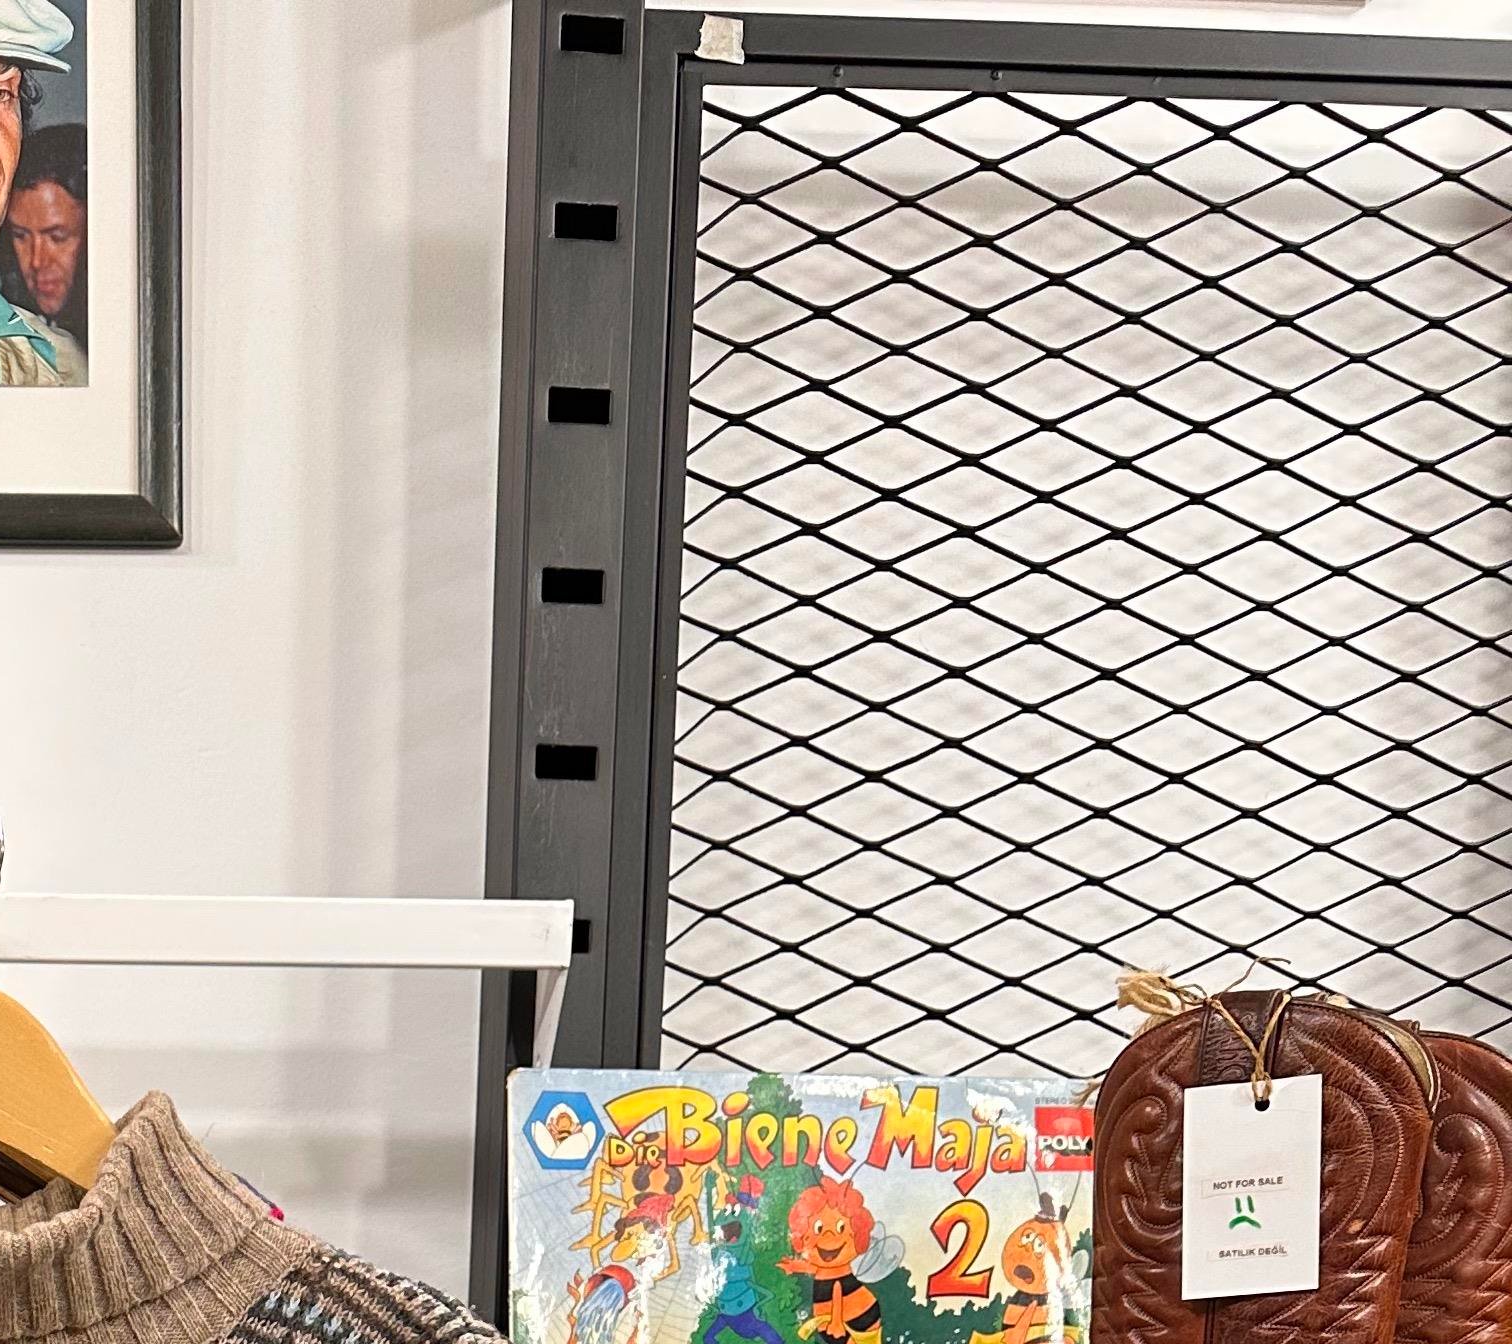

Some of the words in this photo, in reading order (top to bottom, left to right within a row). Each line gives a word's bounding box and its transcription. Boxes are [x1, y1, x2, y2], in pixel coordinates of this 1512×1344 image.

[603, 1086, 857, 1176] Biene
[608, 1131, 662, 1168] Die
[859, 1085, 1028, 1197] Maja
[1039, 1135, 1093, 1156] POLY
[1213, 1180, 1233, 1190] NOT
[1236, 1178, 1255, 1188] FOR
[1258, 1176, 1283, 1186] SALE
[926, 1198, 995, 1300] 2
